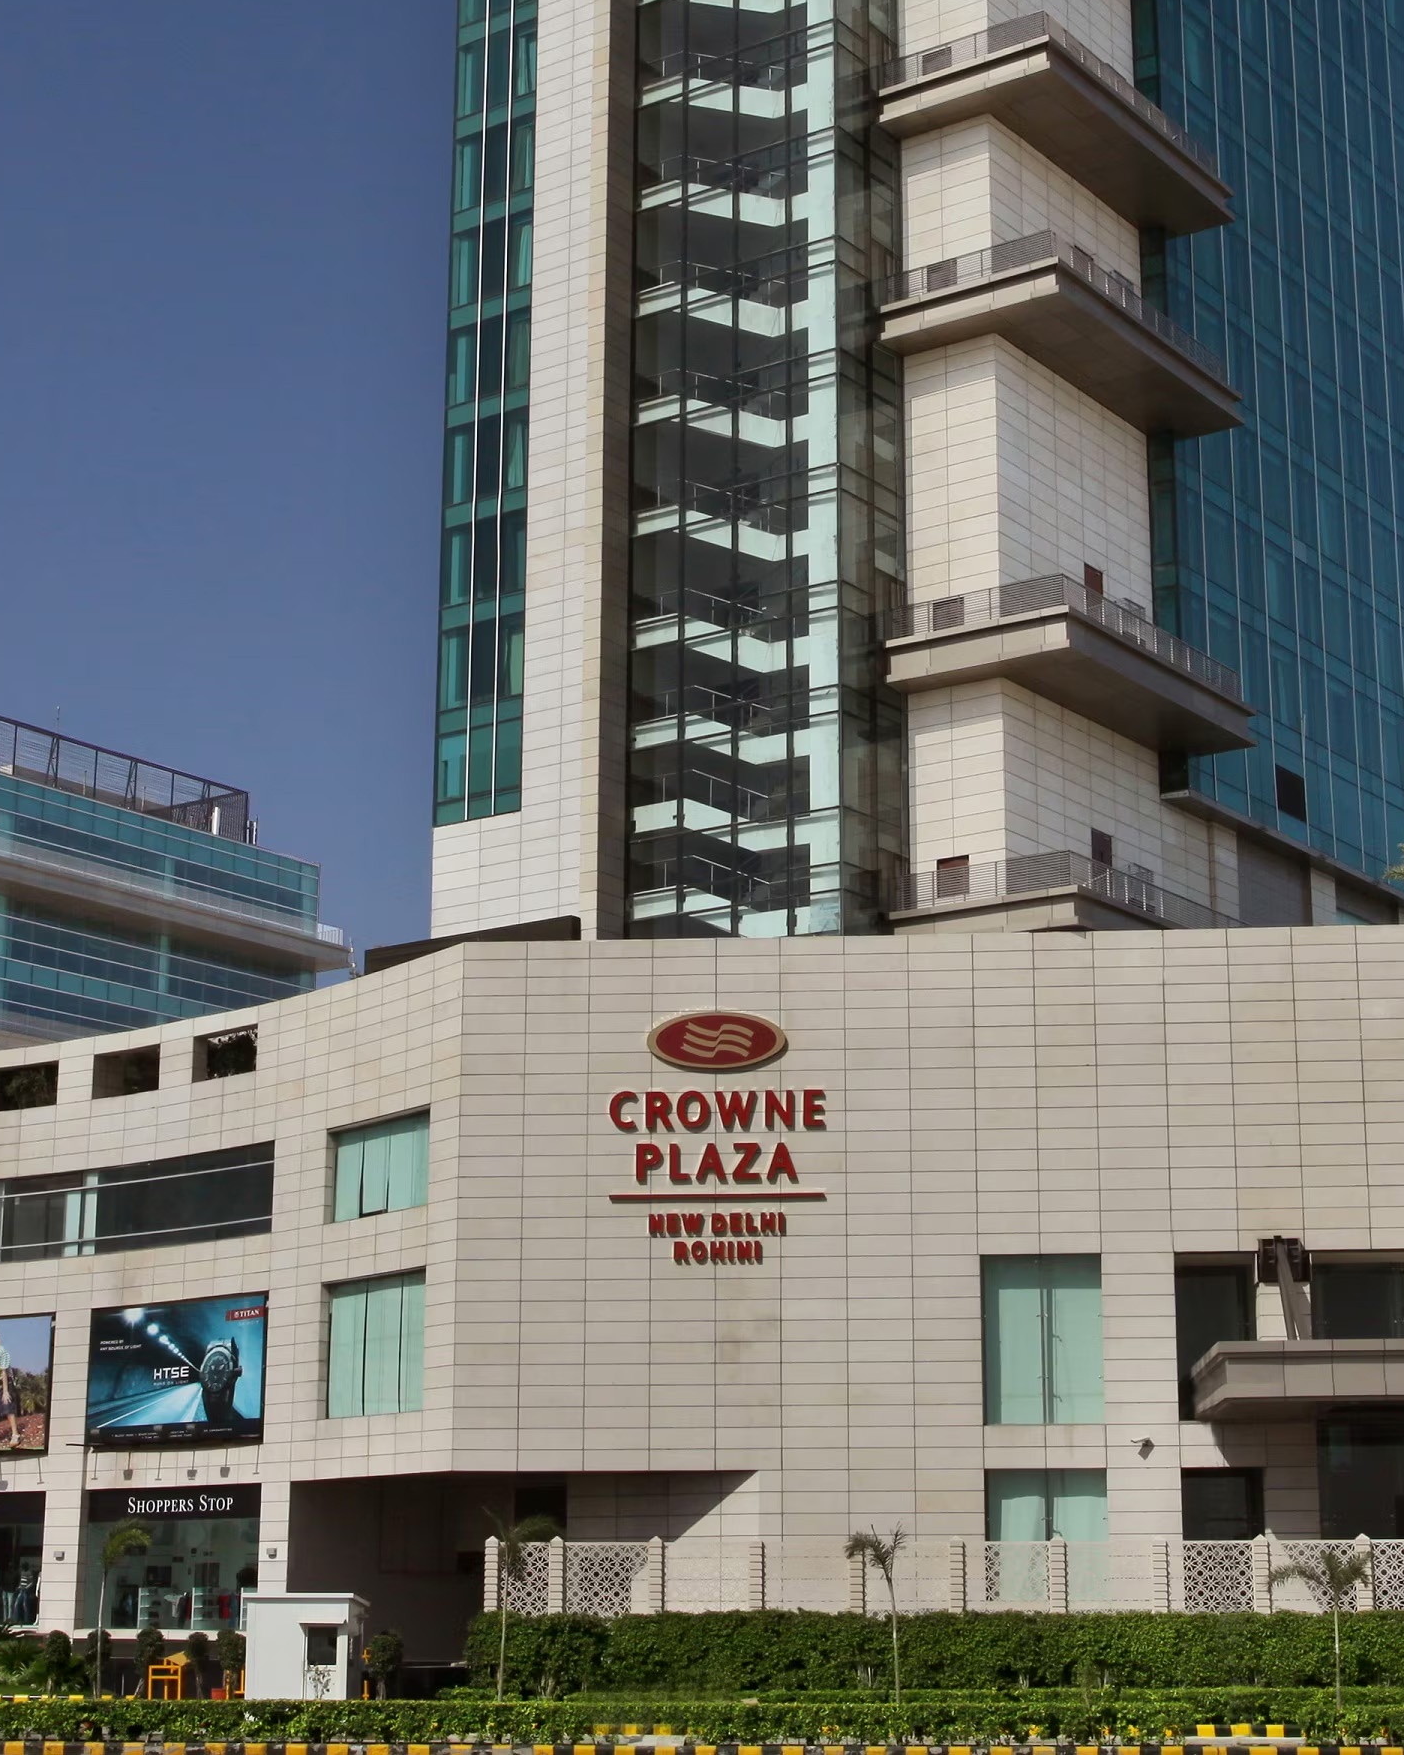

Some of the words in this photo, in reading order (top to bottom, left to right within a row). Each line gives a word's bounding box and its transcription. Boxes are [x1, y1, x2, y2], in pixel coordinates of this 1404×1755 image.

[609, 1089, 827, 1132] CROWNE
[635, 1142, 799, 1184] PLAZA
[648, 1213, 705, 1237] NEW
[711, 1212, 786, 1236] DELHI
[673, 1240, 763, 1265] ROHINI
[239, 1309, 260, 1317] TITAN
[153, 1366, 189, 1380] HTSE
[127, 1496, 194, 1514] SHOPPERS
[199, 1494, 234, 1512] STOP
